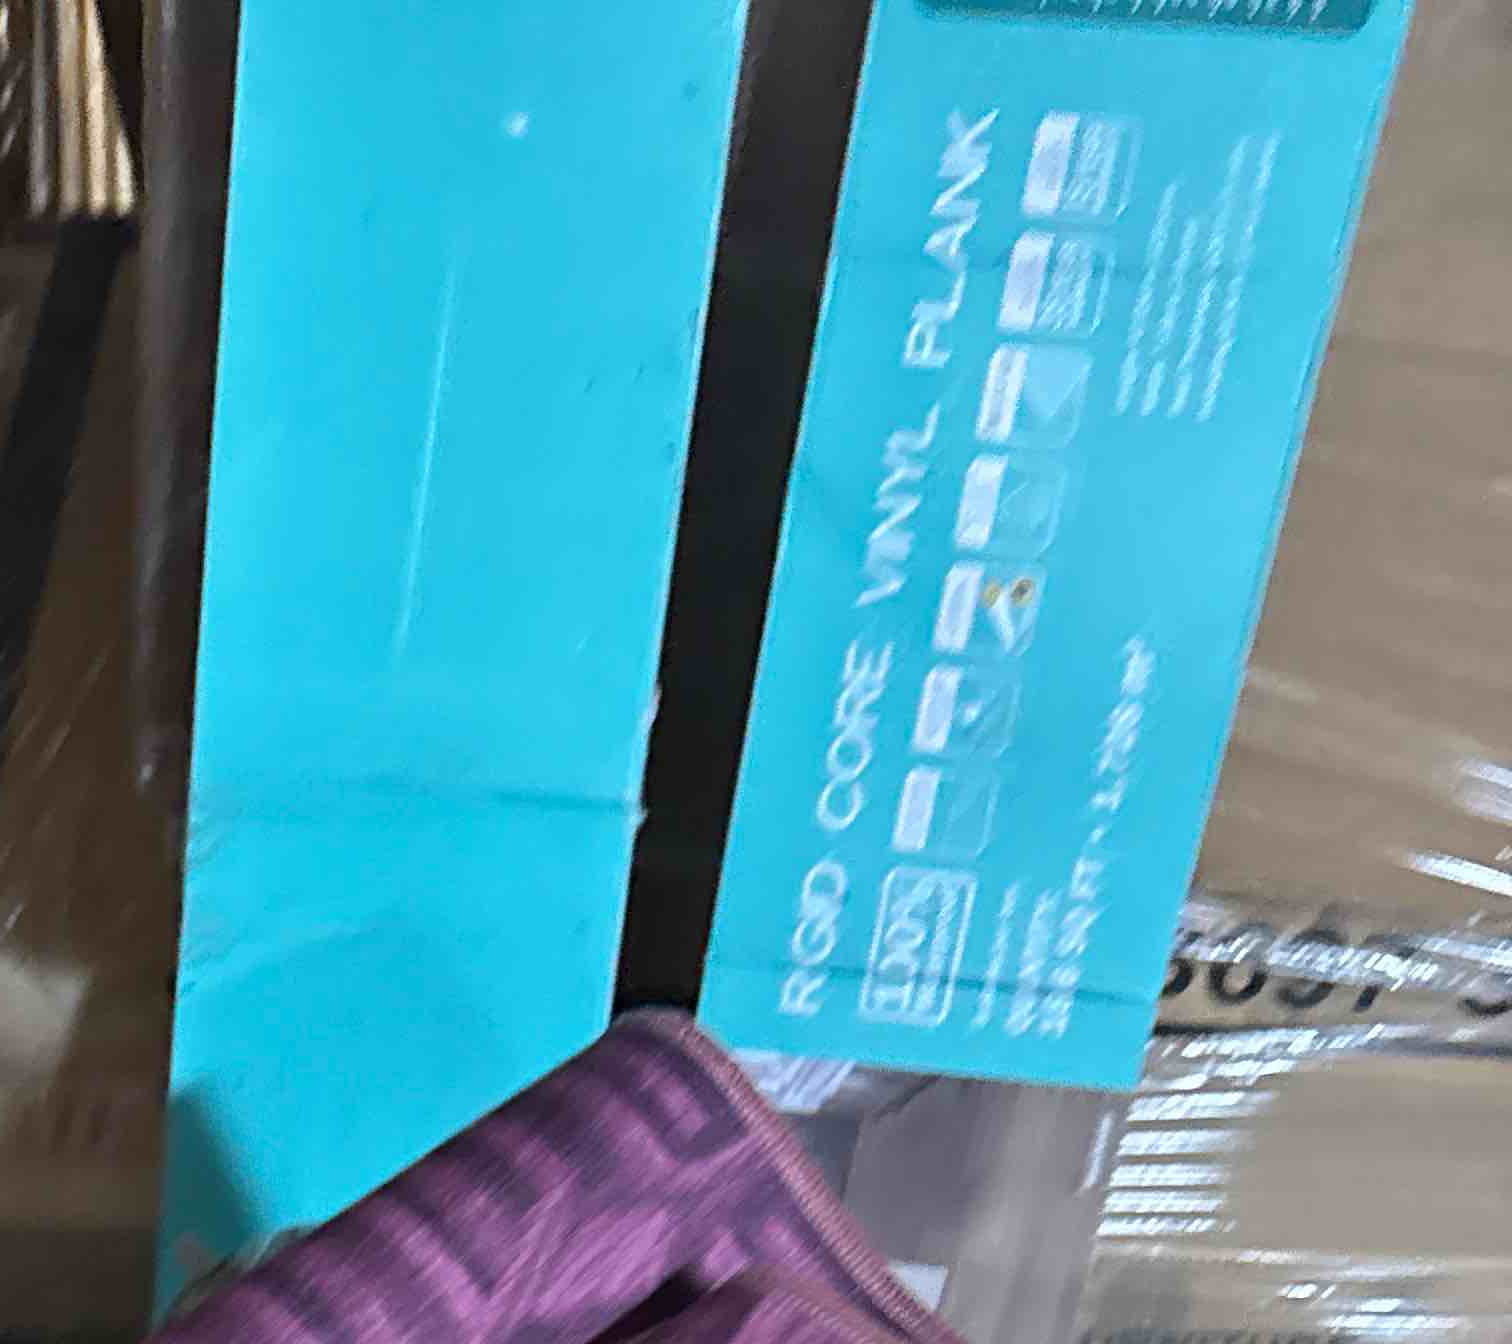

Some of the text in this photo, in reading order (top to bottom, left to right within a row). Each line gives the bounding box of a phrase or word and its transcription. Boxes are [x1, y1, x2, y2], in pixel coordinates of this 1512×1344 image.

[902, 108, 1000, 369] PLANK
[855, 402, 941, 608] VINYL
[816, 640, 895, 832] CORE
